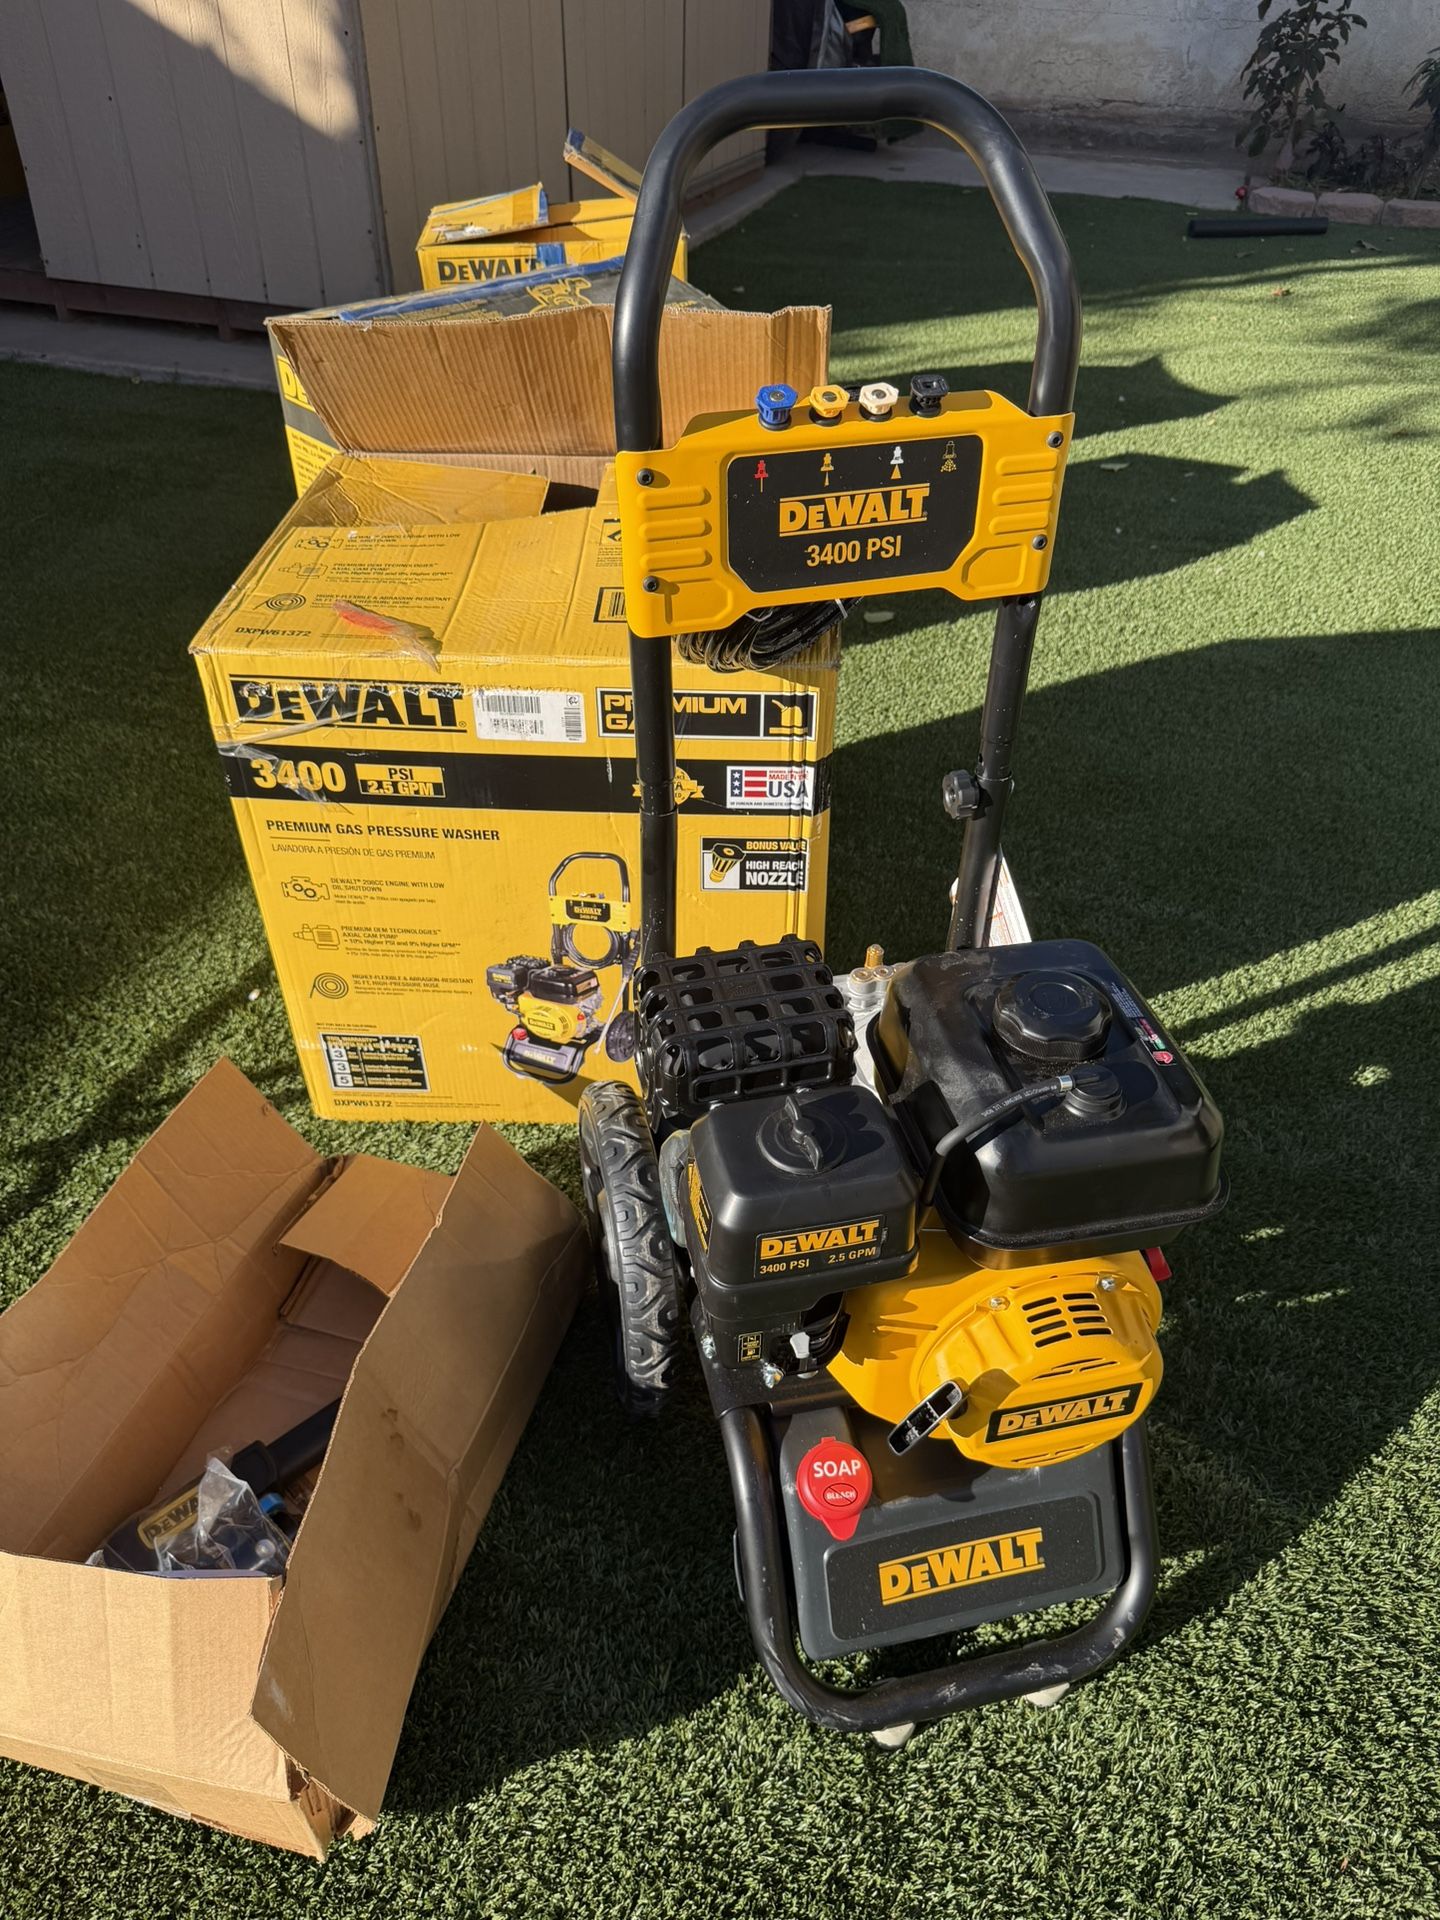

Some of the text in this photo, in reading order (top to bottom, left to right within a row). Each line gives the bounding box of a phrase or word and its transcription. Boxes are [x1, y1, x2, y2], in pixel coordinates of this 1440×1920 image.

[779, 487, 930, 532] DEWALT
[807, 536, 902, 566] 3400 PSI
[235, 627, 311, 637] DXPW61372
[231, 680, 466, 727] DEWALT
[250, 759, 346, 792] 3400
[388, 768, 414, 781] PSI
[368, 781, 434, 796] 2.5 GPM
[769, 781, 809, 798] USA
[266, 820, 500, 841] PREMIUM GAS PRESSURE WASHER
[271, 844, 436, 860] LAVADORA A PRESIÓN DE GAS PREMIUM
[746, 841, 778, 850] BONUS
[746, 860, 770, 870] HIGH
[746, 871, 804, 886] NOZZLE
[333, 1050, 343, 1058] 3
[337, 1063, 346, 1071] 3
[340, 1076, 349, 1084] 5
[334, 1098, 392, 1108] DXPW61372
[761, 1222, 879, 1257] DEWALT
[760, 1247, 877, 1274] 3400 PSI 2.5 GPM
[997, 1391, 1130, 1433] DEWALT
[813, 1460, 861, 1478] SOAP
[827, 1490, 856, 1501] BLEACH
[879, 1531, 1042, 1600] DEWALT
